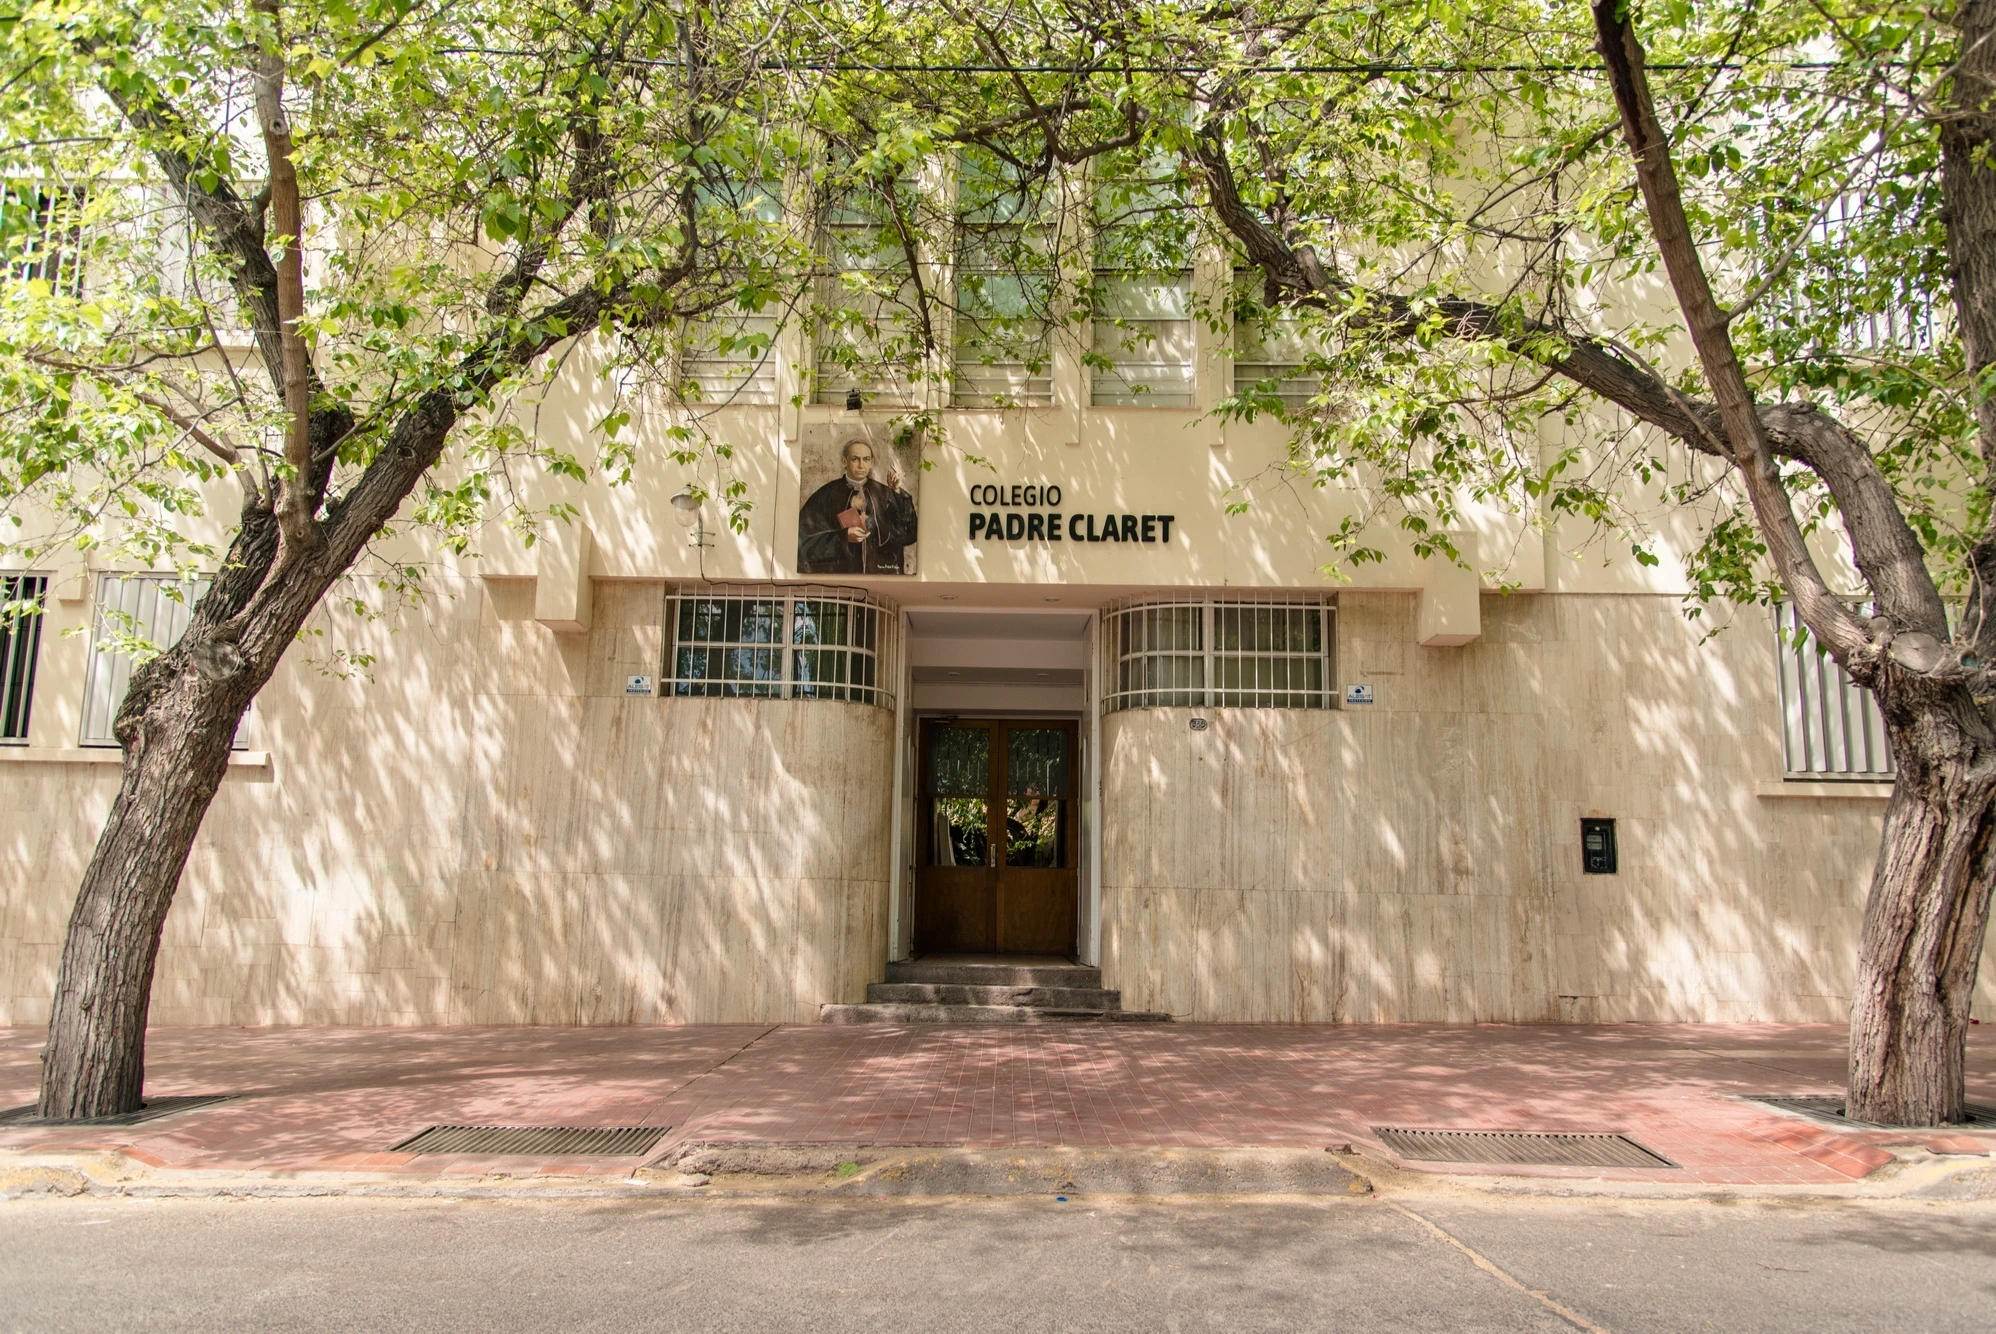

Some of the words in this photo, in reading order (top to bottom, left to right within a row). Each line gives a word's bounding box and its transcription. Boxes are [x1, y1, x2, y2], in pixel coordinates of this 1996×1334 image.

[970, 484, 1062, 507] COLEGIO
[969, 512, 1062, 541] PADRE
[1068, 513, 1175, 543] CLARET
